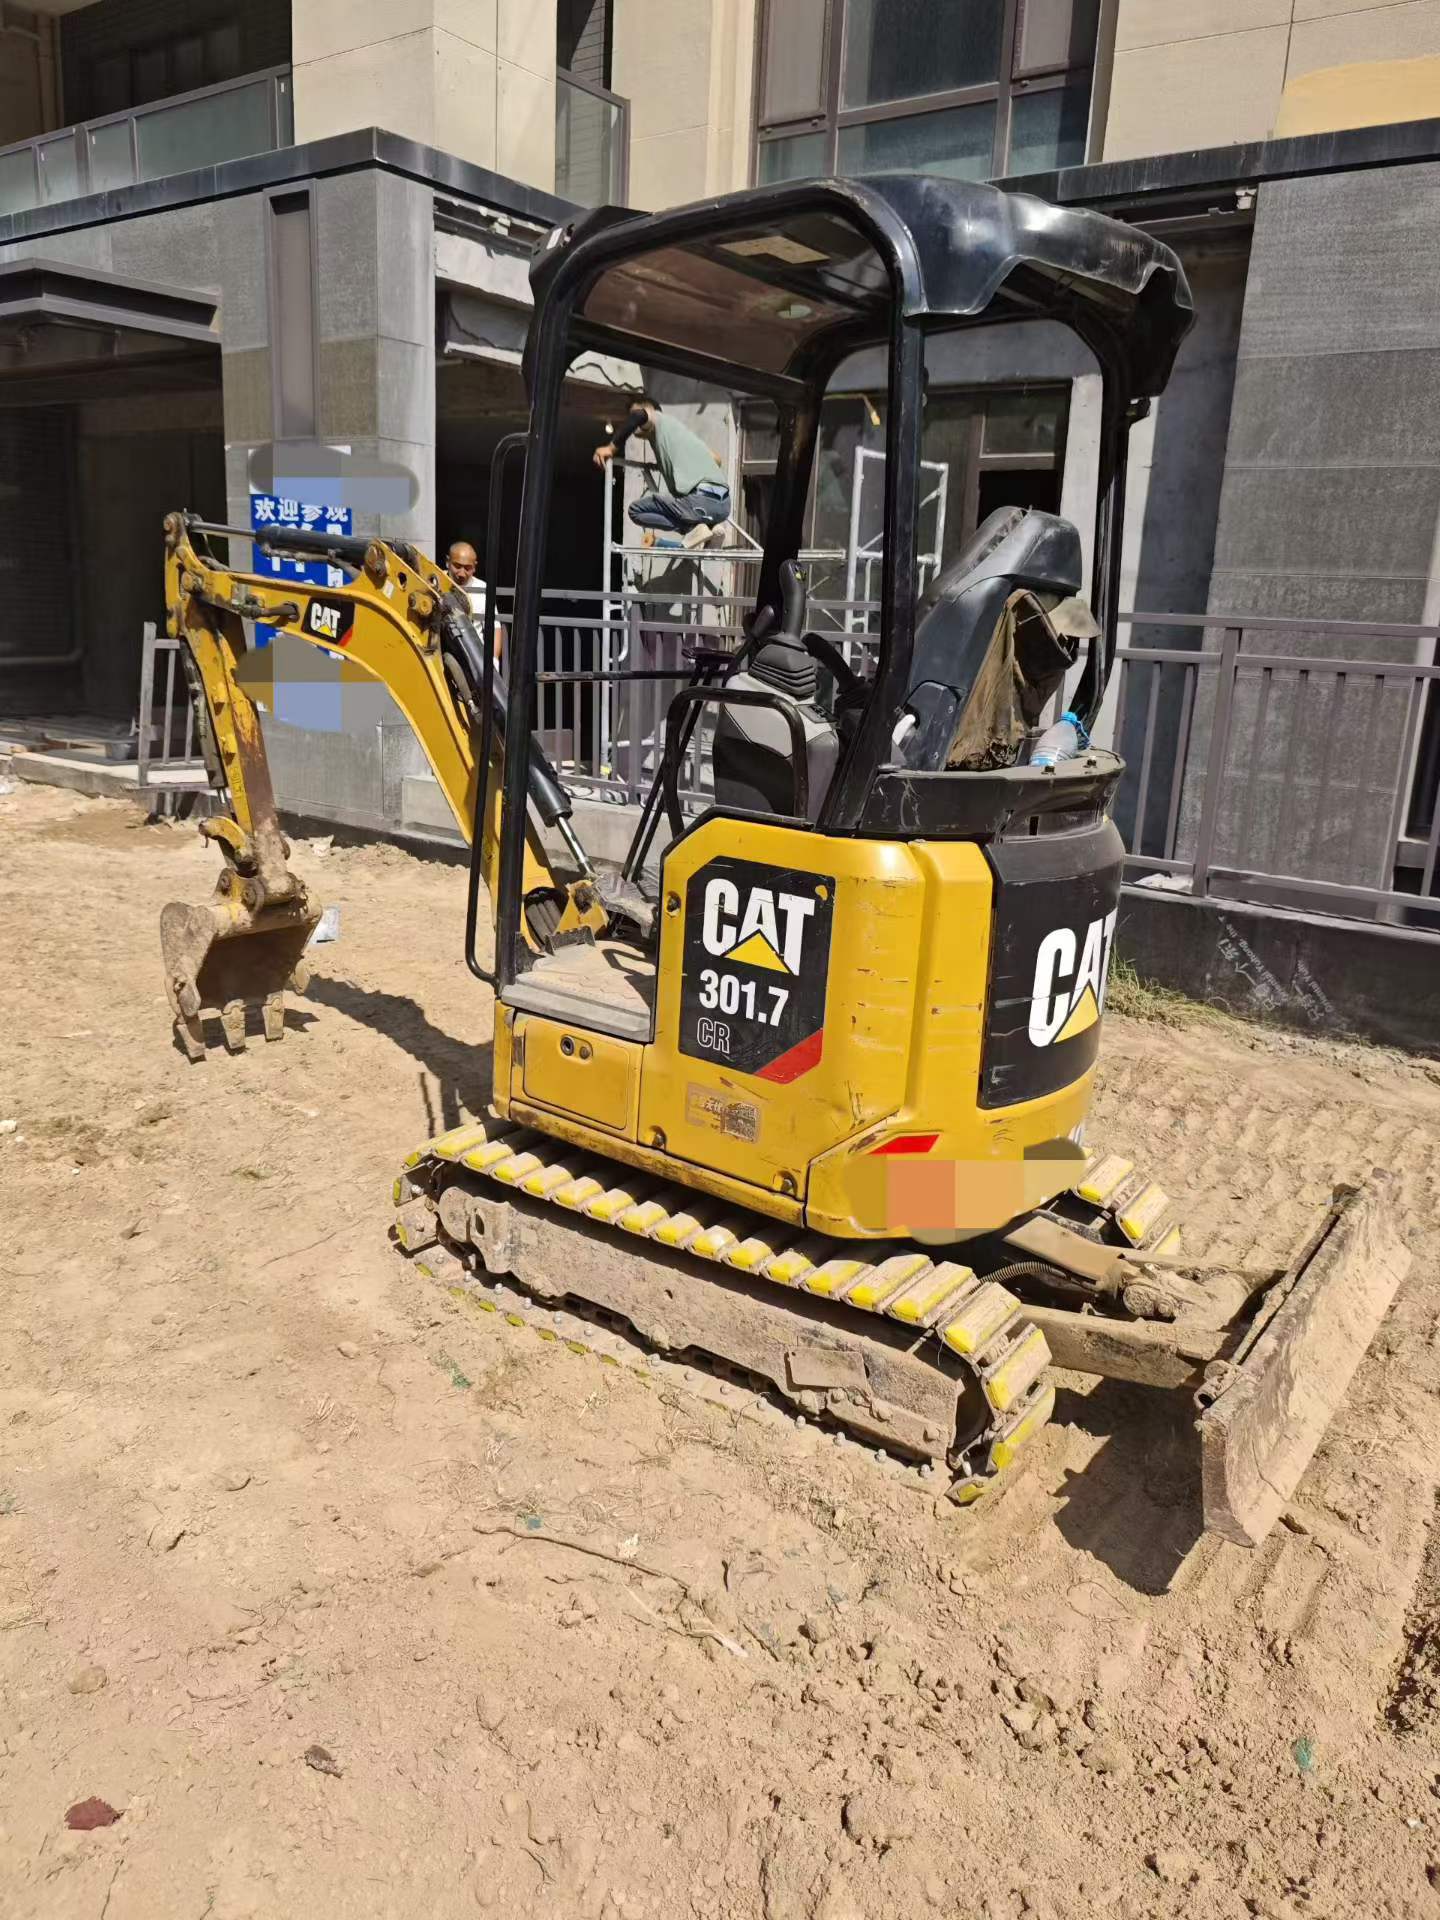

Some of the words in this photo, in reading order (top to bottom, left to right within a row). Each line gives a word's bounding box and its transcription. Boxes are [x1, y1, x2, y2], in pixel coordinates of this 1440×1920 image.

[310, 602, 341, 639] CAT
[702, 878, 816, 976] CAT
[699, 969, 789, 1027] 301.7
[1028, 907, 1119, 1048] CAT
[696, 1017, 731, 1054] CR
